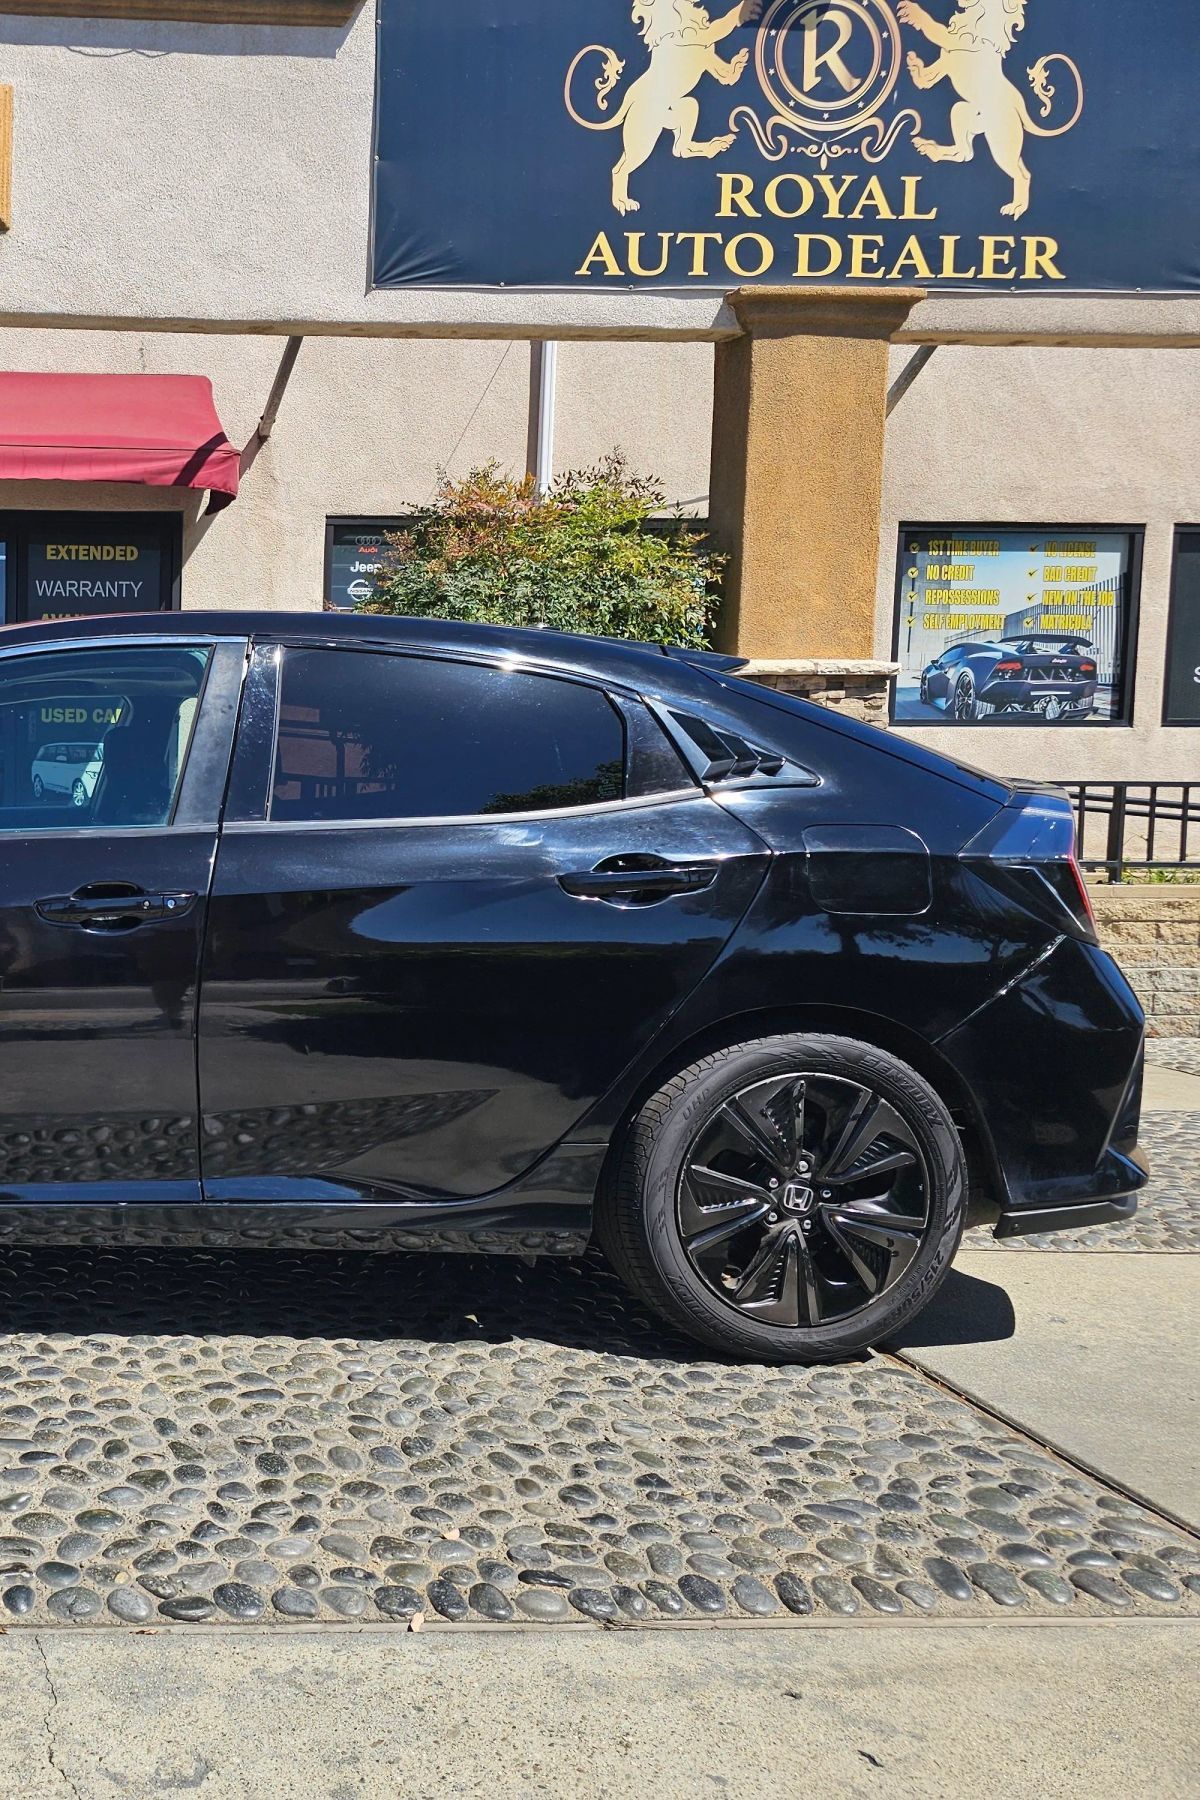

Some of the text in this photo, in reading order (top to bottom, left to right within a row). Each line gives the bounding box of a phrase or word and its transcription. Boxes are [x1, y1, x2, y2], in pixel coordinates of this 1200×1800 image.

[800, 9, 862, 93] R
[715, 173, 937, 220] ROYAL
[575, 232, 1066, 280] AUTO DEALER
[46, 544, 139, 561] EXTENDED
[928, 540, 1000, 557] 1ST TIME BUYER
[1044, 541, 1097, 559] NO LICENSE
[926, 564, 976, 581] NO CREDIT
[1043, 566, 1097, 582] BAD CREDIT
[36, 580, 143, 598] WARRANTY
[925, 589, 1000, 606] REPOSSESSIONS
[1042, 590, 1115, 606] NEW ON THE JOB
[923, 613, 1006, 630] SELF EMPLOYMENT
[1040, 614, 1092, 630] MATRICULA
[41, 708, 87, 723] USED
